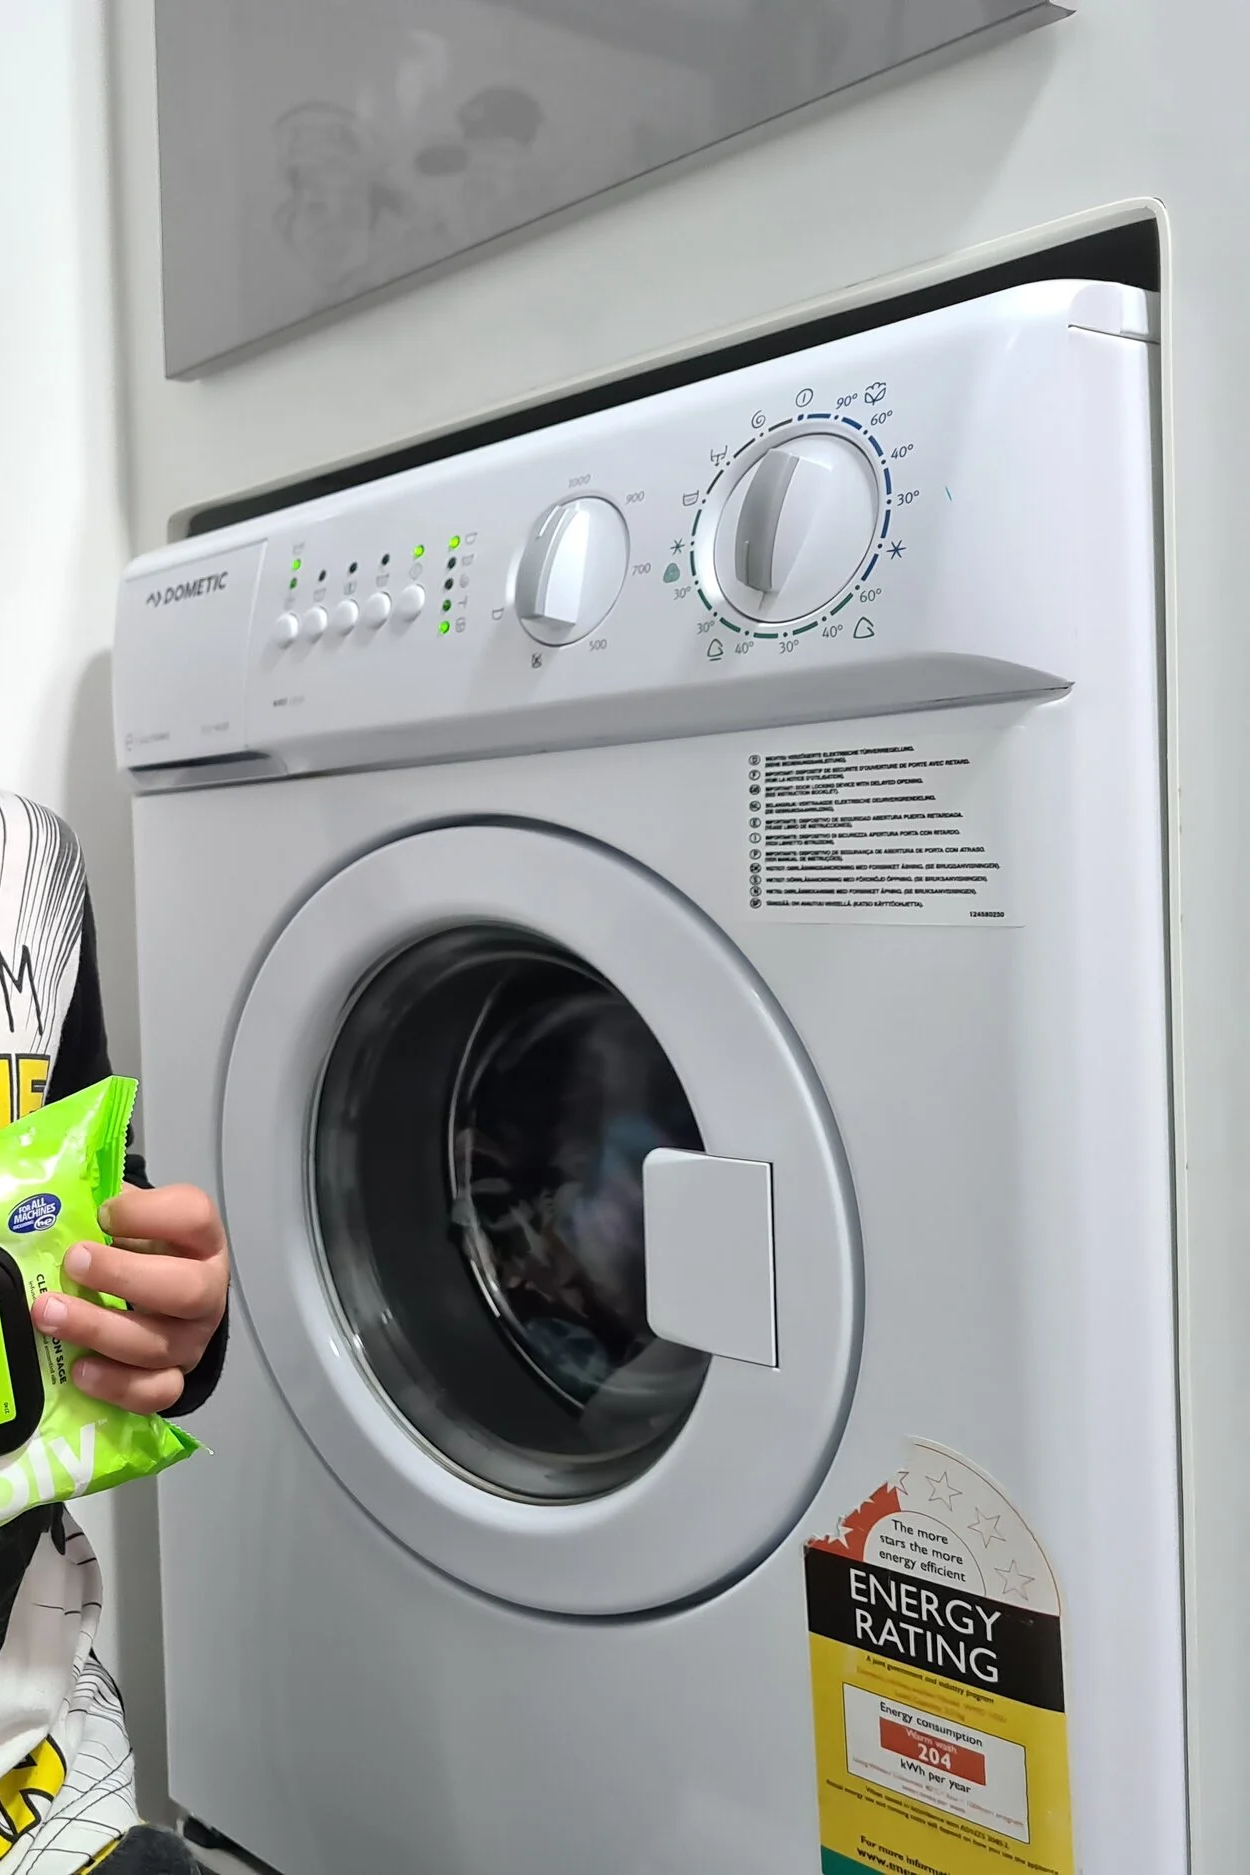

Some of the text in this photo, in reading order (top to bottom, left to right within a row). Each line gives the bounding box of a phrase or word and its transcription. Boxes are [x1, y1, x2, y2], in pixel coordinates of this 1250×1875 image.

[568, 474, 591, 489] 1000
[625, 491, 646, 505] 900
[632, 563, 651, 577] 700
[164, 571, 229, 605] DOMETIC
[589, 638, 607, 652] 500
[13, 1202, 56, 1225] MACHINES
[31, 1197, 47, 1210] ALL
[56, 1355, 67, 1385] SAGE
[891, 1518, 949, 1545] The more
[879, 1534, 963, 1565] stars the more
[879, 1550, 967, 1582] energy efficient
[849, 1567, 1002, 1642] ENERGY
[855, 1608, 999, 1684] RATING
[880, 1701, 913, 1724] Energy
[916, 1717, 983, 1747] consumption
[905, 1727, 958, 1755] Warm wash
[917, 1743, 952, 1770] 204
[900, 1758, 971, 1794] kWh per year
[860, 1835, 876, 1848] For
[878, 1844, 904, 1861] more
